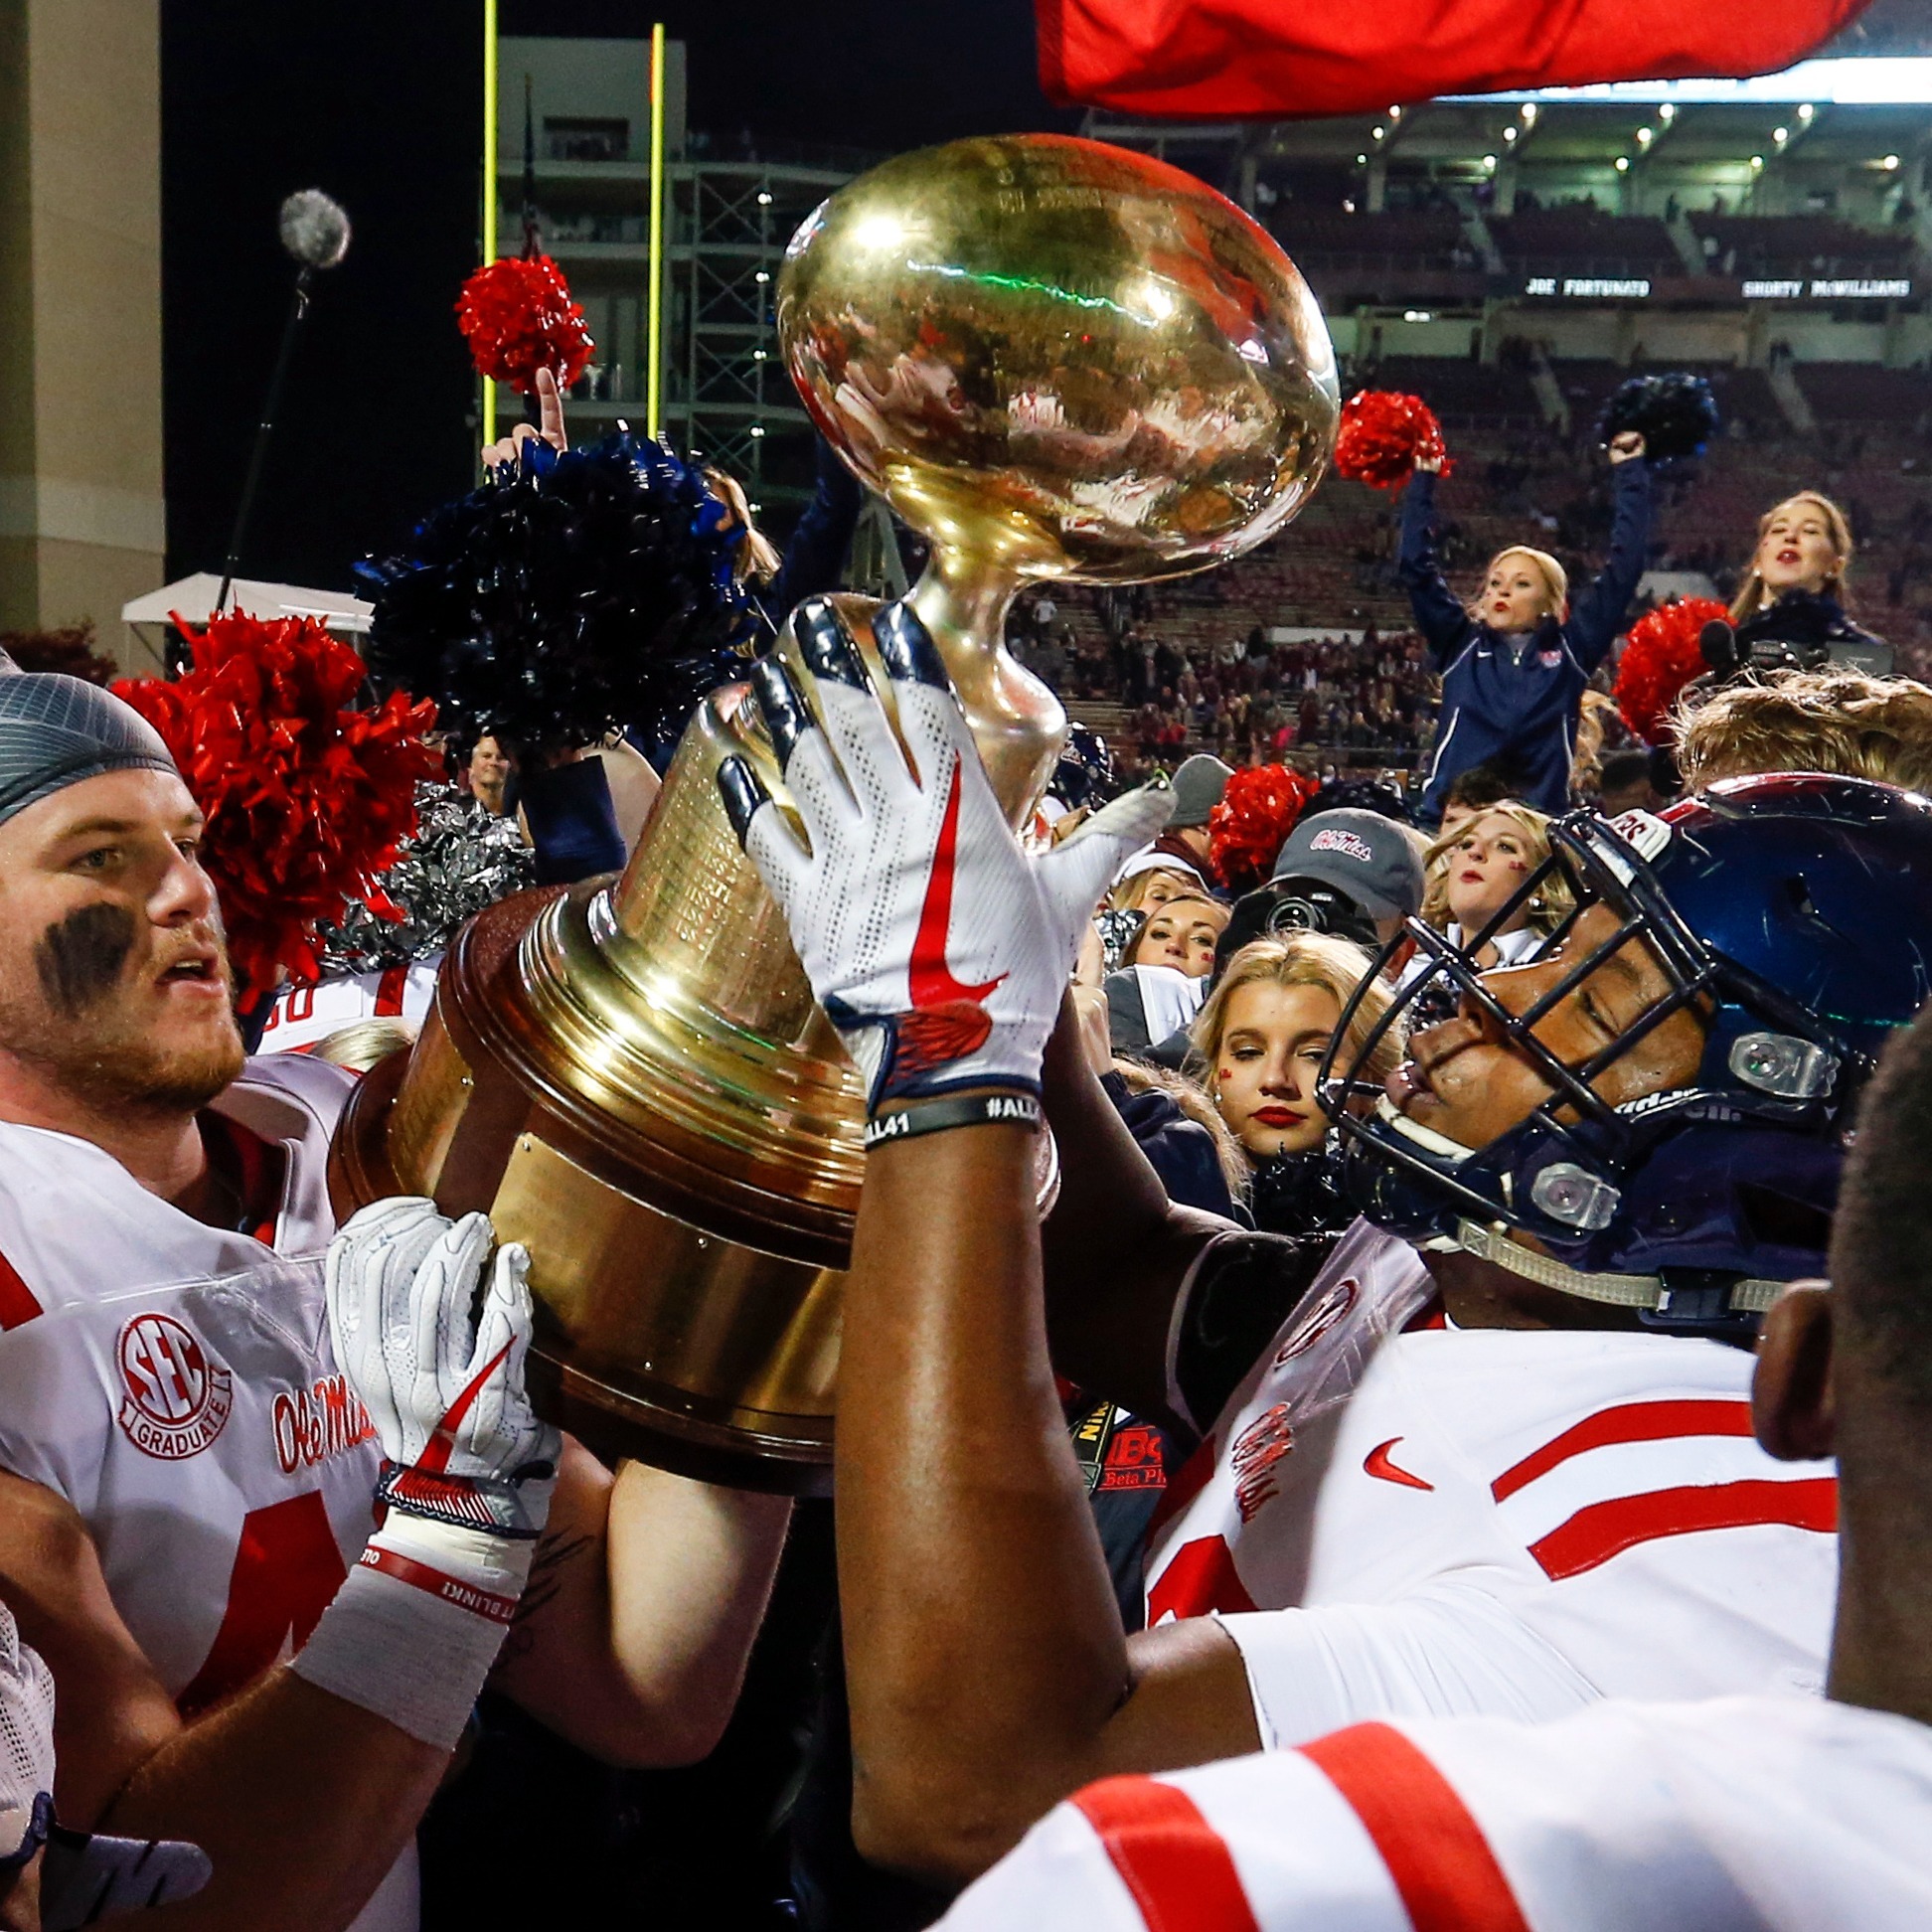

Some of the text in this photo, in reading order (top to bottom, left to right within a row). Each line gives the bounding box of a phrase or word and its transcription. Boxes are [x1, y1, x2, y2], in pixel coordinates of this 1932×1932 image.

[1526, 278, 1650, 296] JOE FORTUNATO
[1741, 280, 1803, 297] SHORTY
[1337, 831, 1372, 861] Miss
[125, 1320, 203, 1418] SEC
[136, 1399, 227, 1455] GRADUATE
[271, 1371, 381, 1474] Ole Mis
[1103, 1471, 1139, 1487] Beta
[443, 1581, 497, 1616] BLINK!
